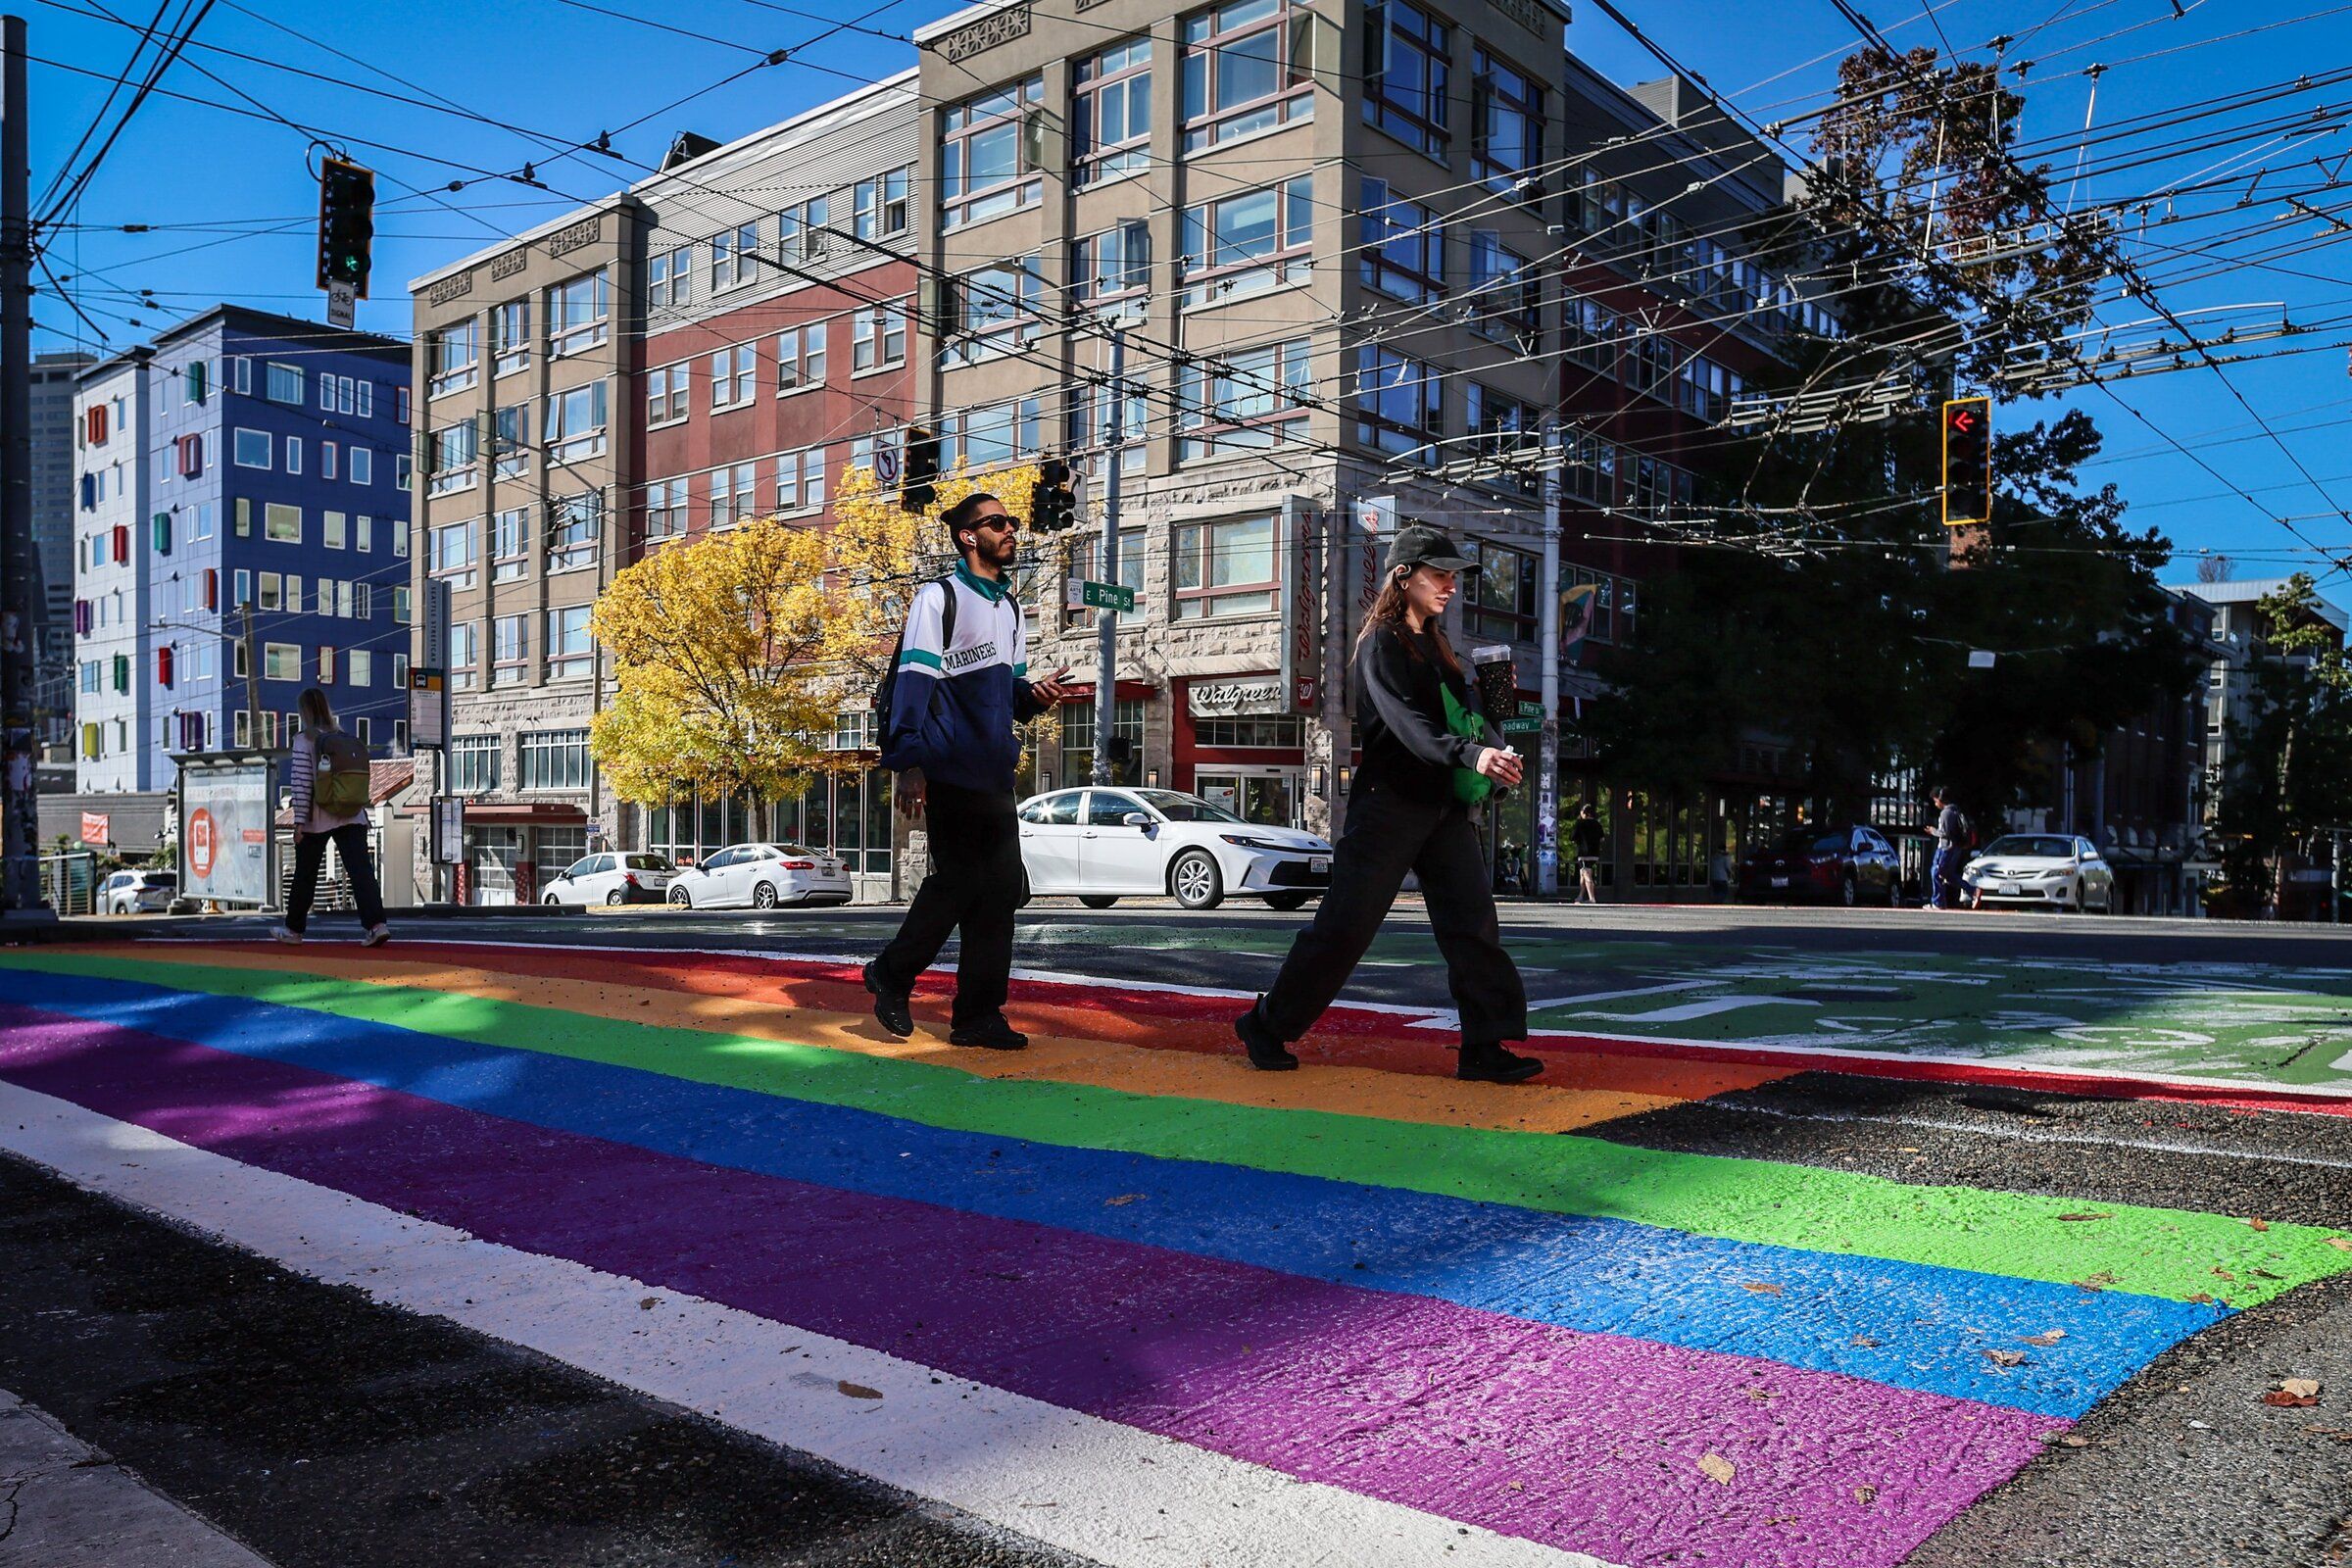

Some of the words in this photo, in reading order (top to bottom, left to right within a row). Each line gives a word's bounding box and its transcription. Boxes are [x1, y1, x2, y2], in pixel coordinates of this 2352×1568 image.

[1086, 590, 1091, 600] E
[1099, 589, 1118, 604] Pine
[1123, 596, 1130, 607] St
[1298, 509, 1317, 662] Walgreens
[944, 641, 997, 671] MARINERS
[1197, 684, 1281, 710] Walgreen
[1503, 721, 1529, 730] oadway
